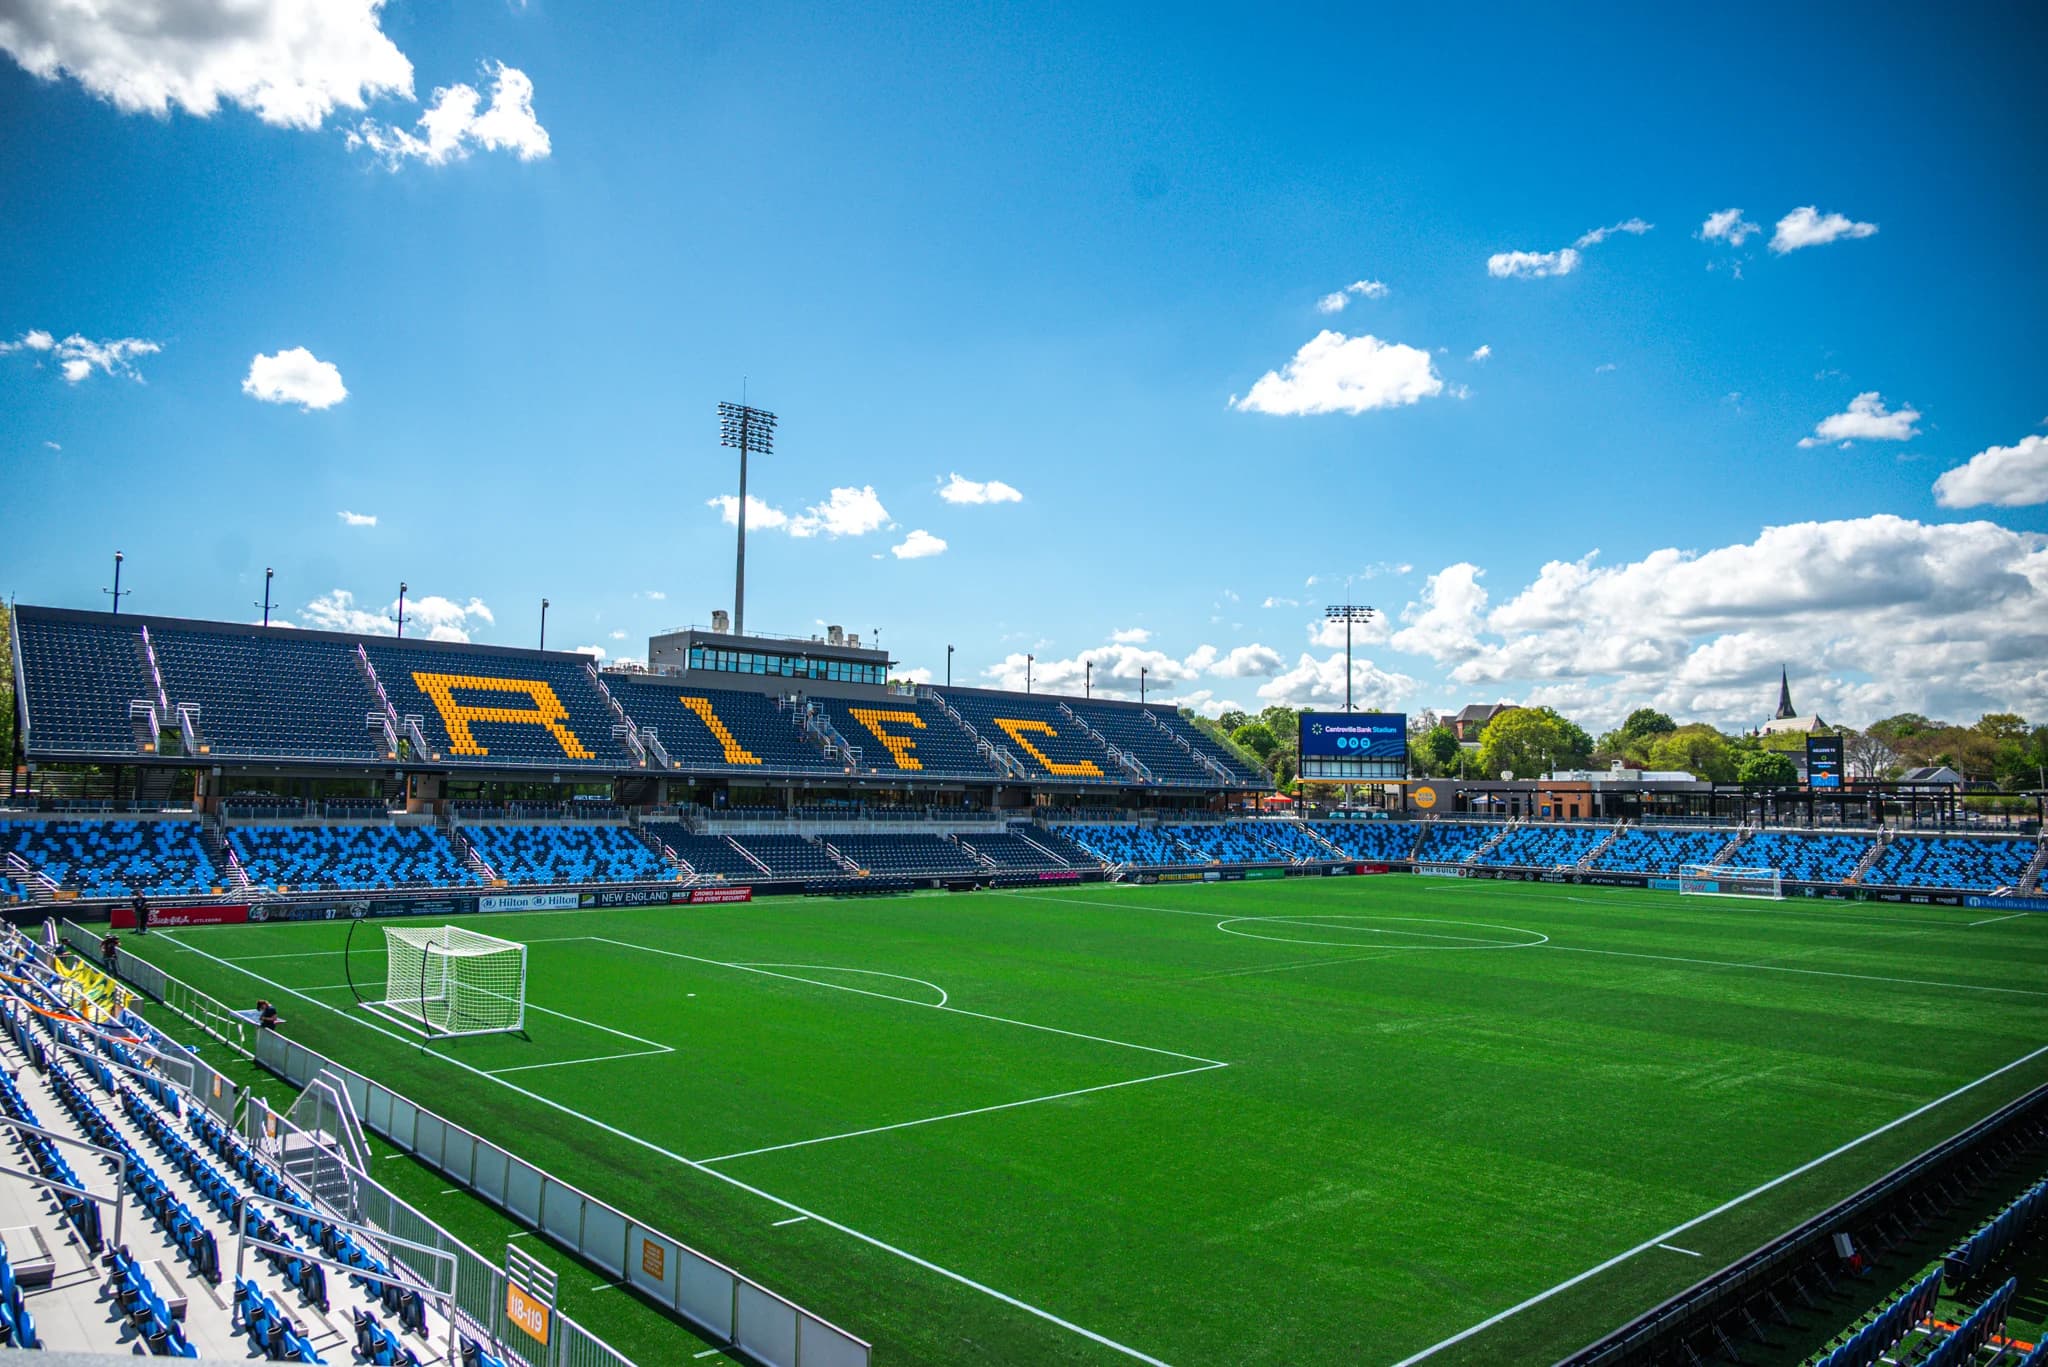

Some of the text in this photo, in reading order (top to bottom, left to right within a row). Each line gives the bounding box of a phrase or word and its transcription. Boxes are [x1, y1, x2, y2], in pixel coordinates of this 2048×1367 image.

[1421, 865, 1434, 873] THE
[549, 896, 577, 905] Hilton
[602, 891, 668, 903] NEW ENGLAND
[499, 898, 528, 907] Hilton
[325, 908, 336, 919] 37
[511, 1293, 543, 1333] 118-119
